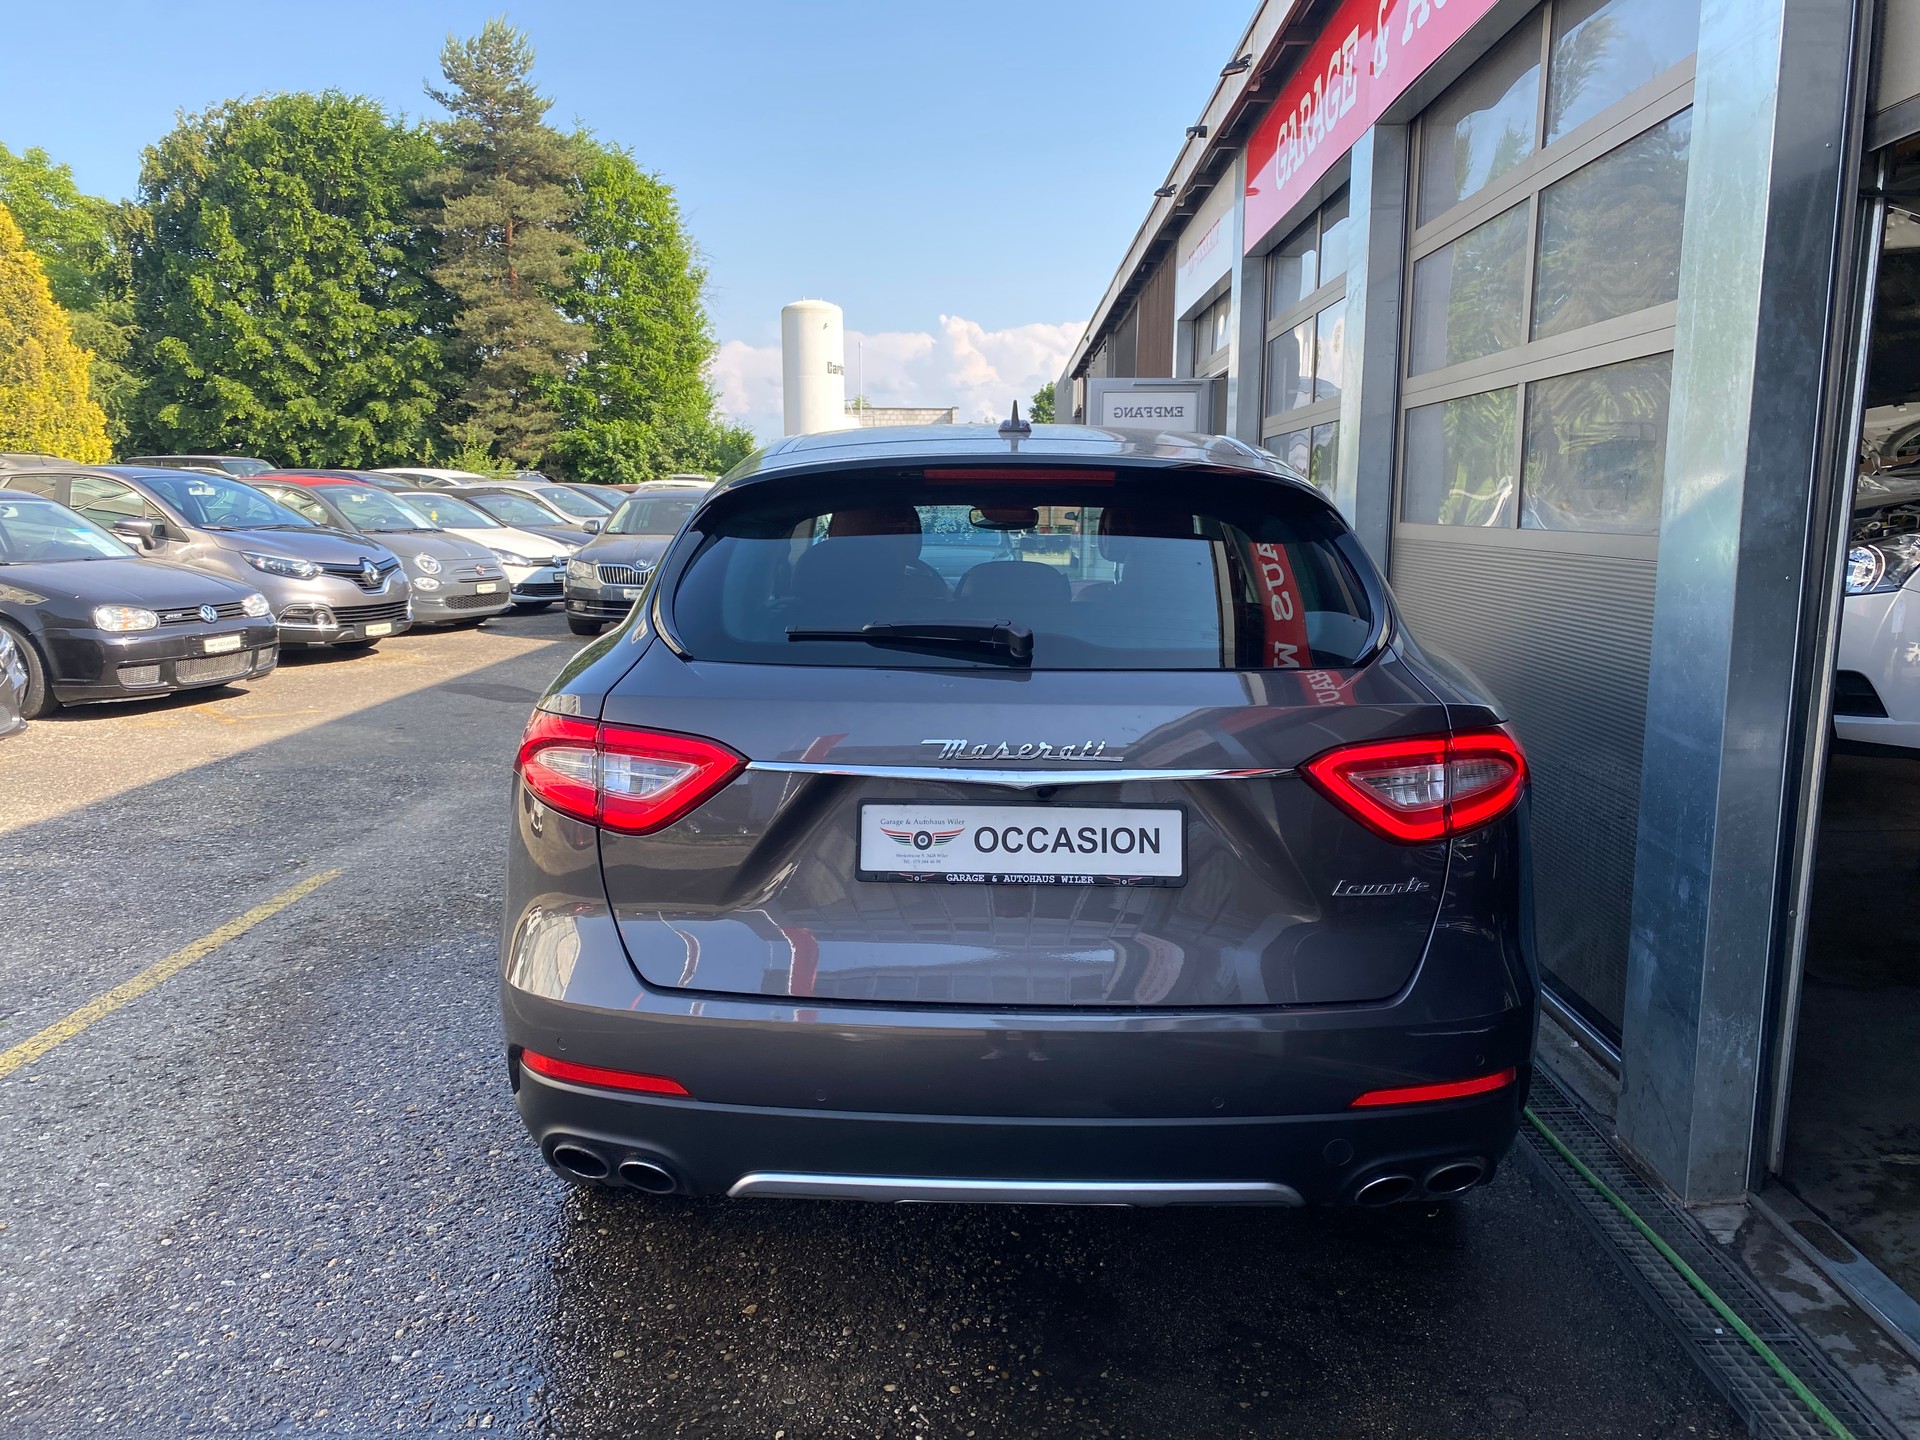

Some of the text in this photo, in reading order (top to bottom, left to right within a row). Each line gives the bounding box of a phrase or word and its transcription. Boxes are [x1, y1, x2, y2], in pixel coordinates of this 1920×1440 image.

[1275, 24, 1360, 191] GARAGE
[1373, 0, 1390, 80] &
[921, 738, 1124, 762] Maserati
[880, 818, 904, 826] Garage
[973, 826, 1161, 854] OCCASION
[946, 873, 985, 882] GARAGE
[1003, 874, 1055, 883] AUTOHAUS
[1061, 876, 1095, 884] WILER
[1332, 876, 1431, 896] Levante
